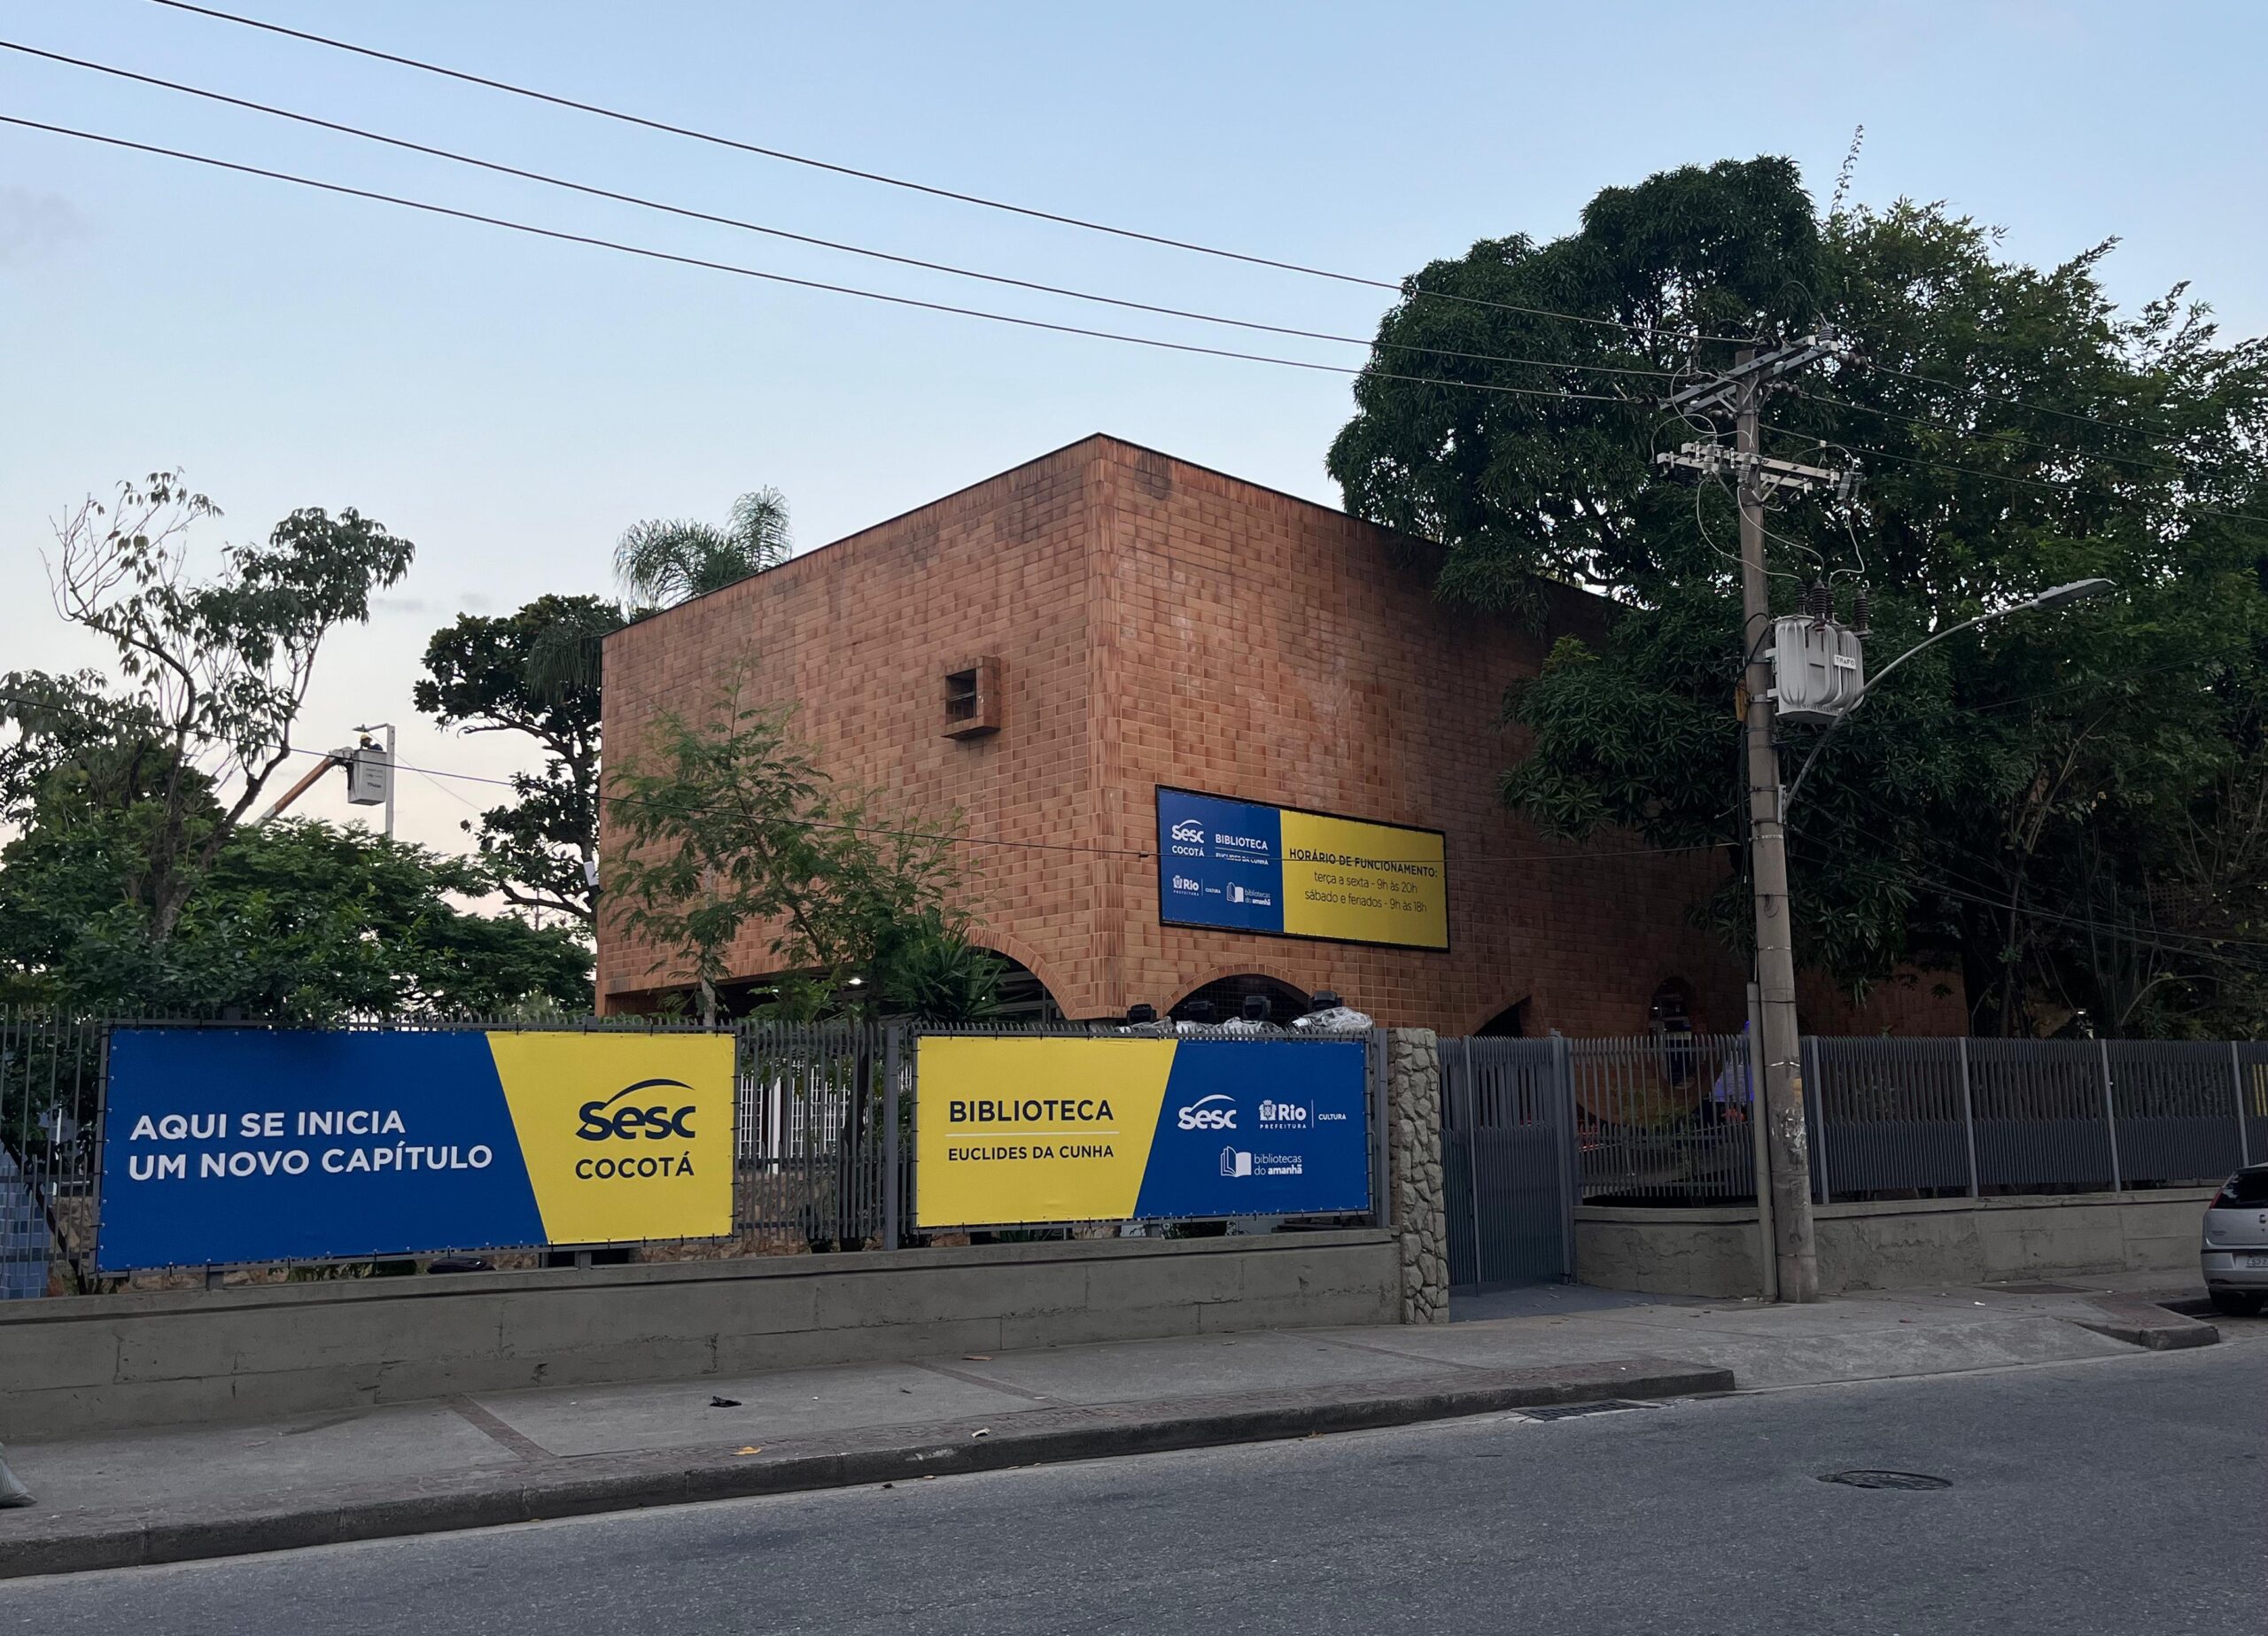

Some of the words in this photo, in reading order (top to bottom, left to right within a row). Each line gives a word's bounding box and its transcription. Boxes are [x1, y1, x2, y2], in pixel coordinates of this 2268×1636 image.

[1171, 825, 1205, 844] Sesc
[1215, 834, 1269, 850] BIBLIOTECA
[1171, 845, 1205, 857] COCOTÁ
[1289, 848, 1336, 865] HORÁRIO
[1339, 855, 1352, 867] DE
[1355, 857, 1438, 878] FUNCIONAMENTO:
[1183, 879, 1200, 891] Rio
[1314, 872, 1337, 885] terça
[1339, 875, 1345, 884] a
[1347, 875, 1370, 888] sexta
[1377, 879, 1388, 890] 9h
[1390, 880, 1400, 892] às
[1402, 881, 1418, 895] 20h
[1305, 889, 1339, 903] sábado
[1340, 894, 1347, 903] e
[1348, 893, 1383, 909] feriados
[1389, 898, 1401, 910] 9h
[1402, 899, 1412, 911] às
[1414, 901, 1427, 913] 18h
[575, 1101, 696, 1142] Sesc
[950, 1099, 1114, 1122] BIBLIOTECA
[1177, 1106, 1237, 1130] Sesc
[1278, 1104, 1307, 1121] Rio
[129, 1113, 227, 1141] AQUI
[240, 1112, 284, 1137] SE
[297, 1110, 406, 1136] INICIA
[128, 1153, 186, 1181] UM
[200, 1150, 309, 1178] NOVO
[322, 1141, 493, 1174] CAPÍTULO
[949, 1146, 1028, 1161] EUCLIDES
[1032, 1145, 1054, 1159] DA
[1060, 1144, 1115, 1159] CUNHA
[1254, 1153, 1302, 1165] bibliotecas
[575, 1151, 695, 1180] COCOTÁ
[1254, 1166, 1266, 1175] do
[1267, 1163, 1303, 1175] amanhã
